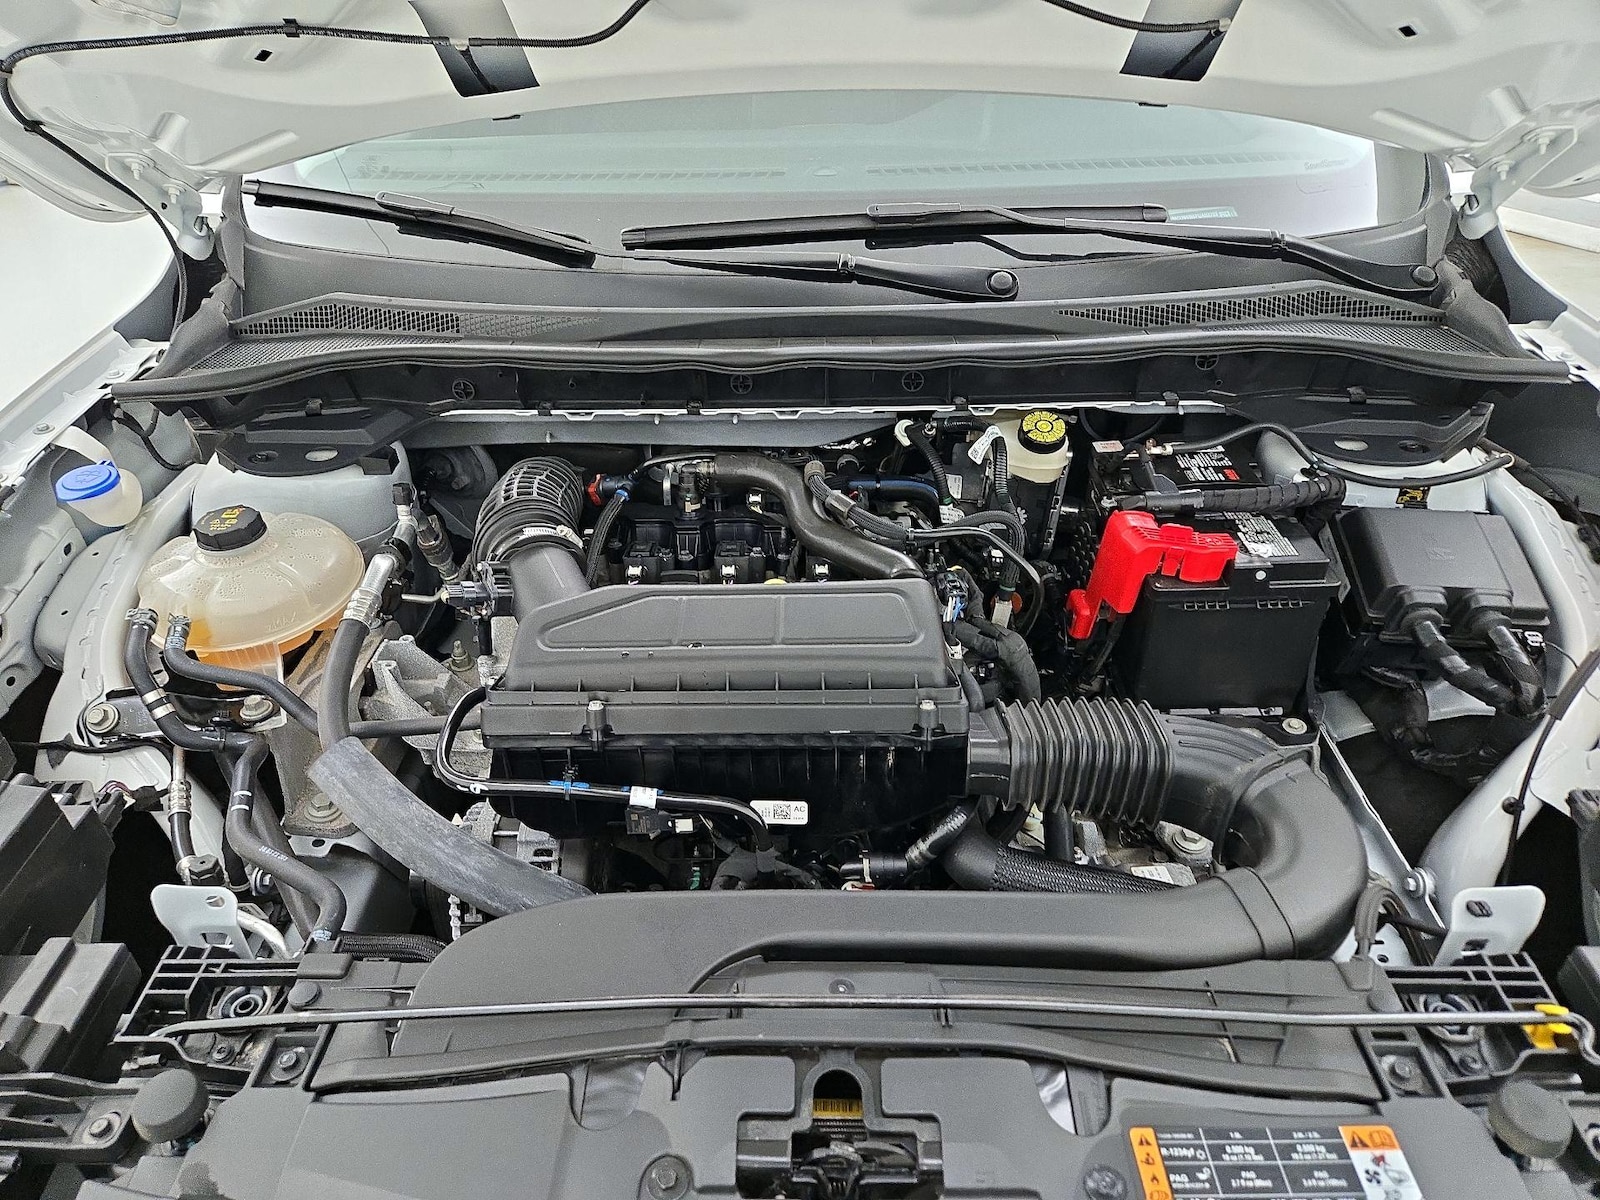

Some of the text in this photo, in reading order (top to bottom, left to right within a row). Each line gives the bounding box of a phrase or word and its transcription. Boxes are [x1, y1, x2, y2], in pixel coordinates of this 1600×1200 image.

[793, 805, 806, 813] AC
[1160, 1146, 1195, 1159] R-1234yf
[1169, 1173, 1189, 1183] PAG
[1240, 1170, 1257, 1179] PAG
